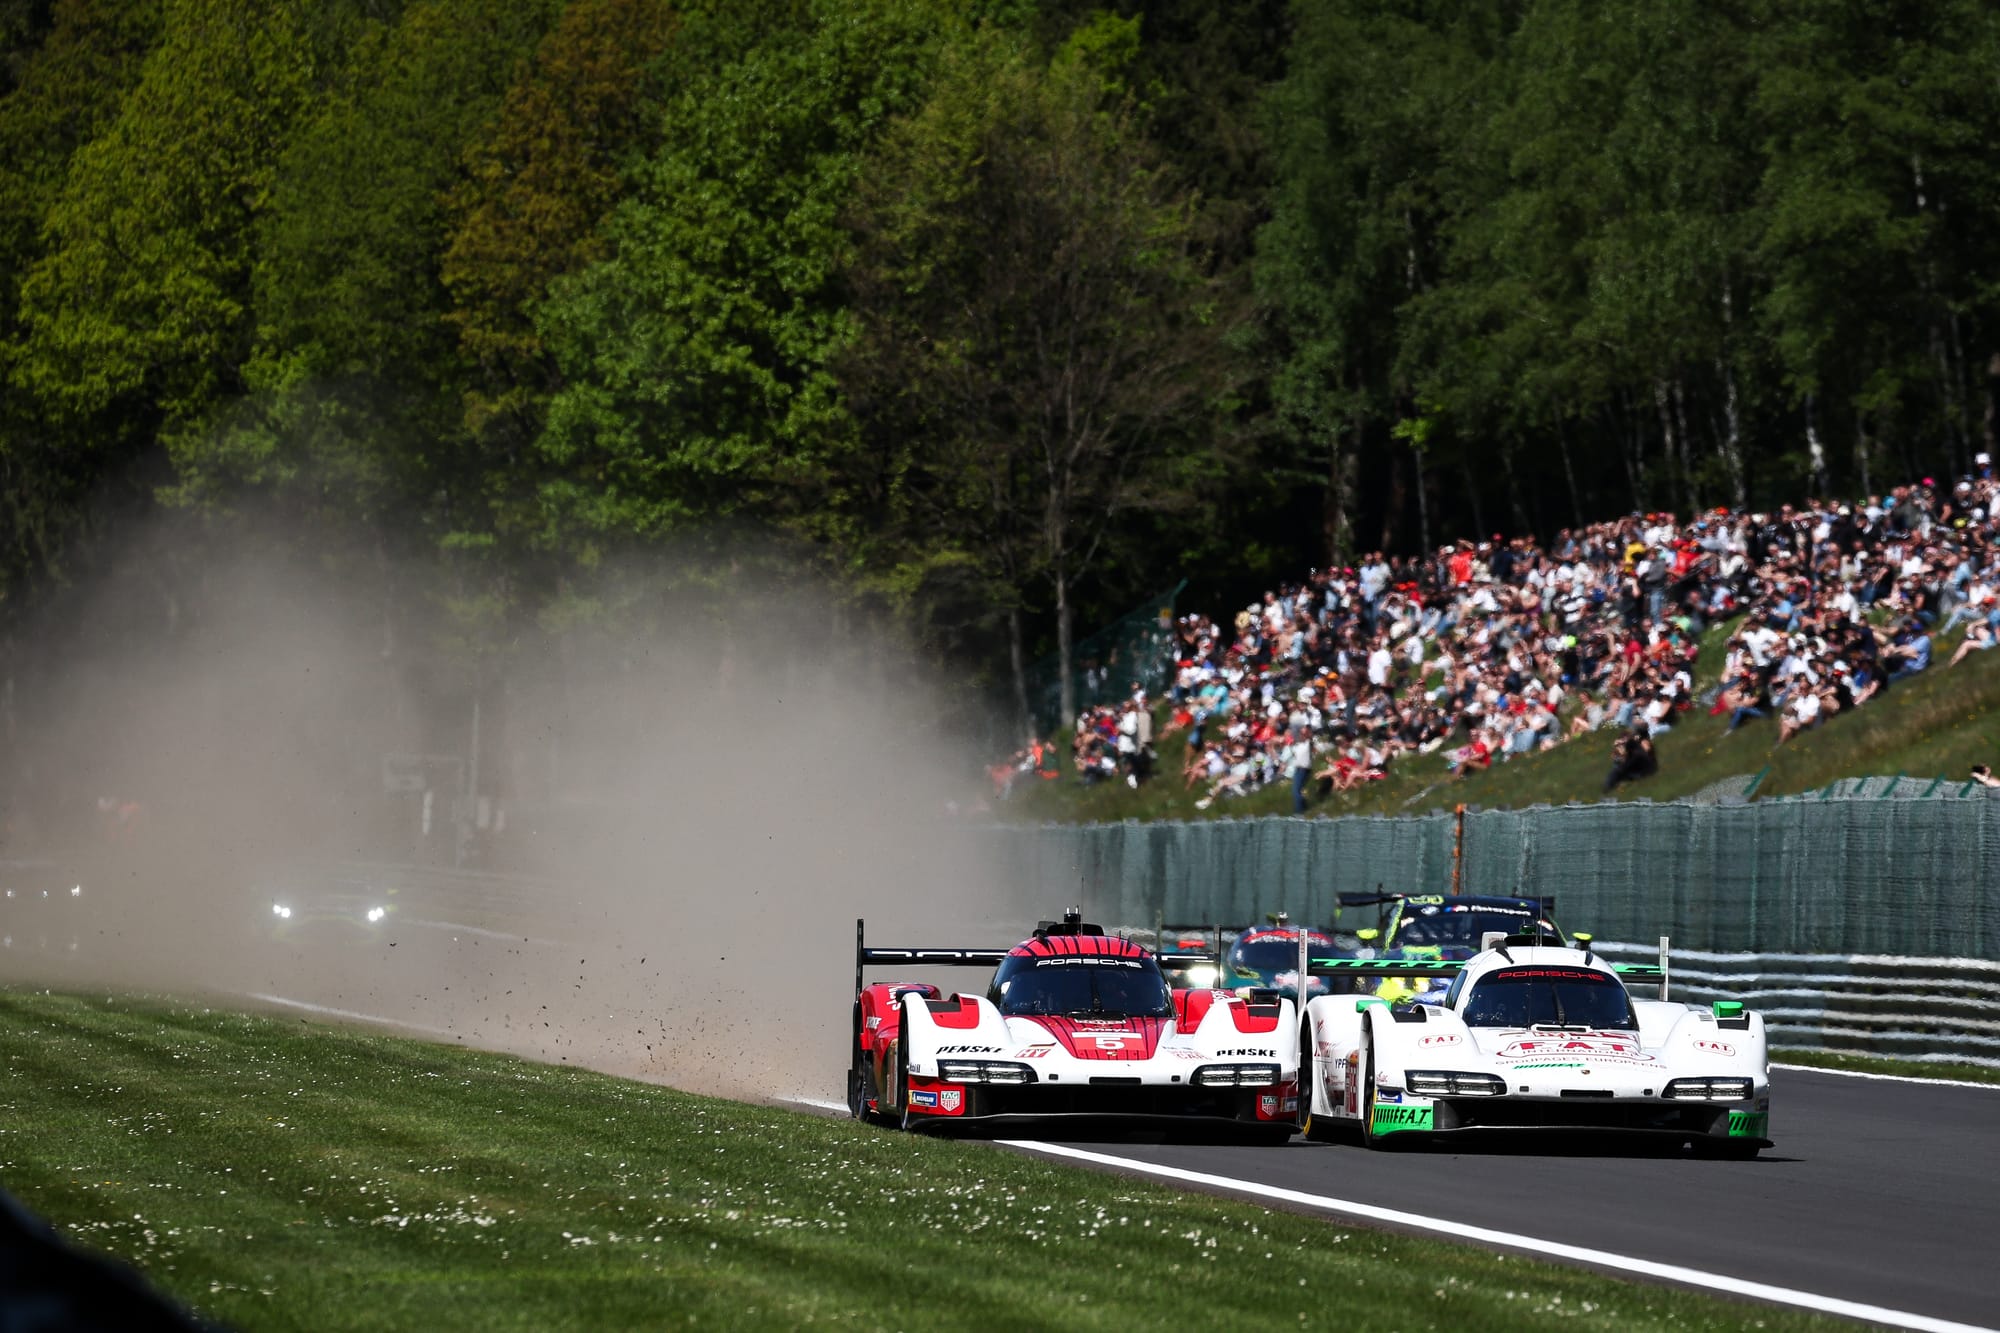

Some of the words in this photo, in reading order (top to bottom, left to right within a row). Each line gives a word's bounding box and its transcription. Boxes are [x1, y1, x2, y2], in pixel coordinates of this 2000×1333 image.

[1036, 958, 1142, 968] PORSCHE
[1498, 971, 1605, 981] PORSCHE
[1095, 1037, 1125, 1050] 5
[1216, 1048, 1278, 1058] PENSKE
